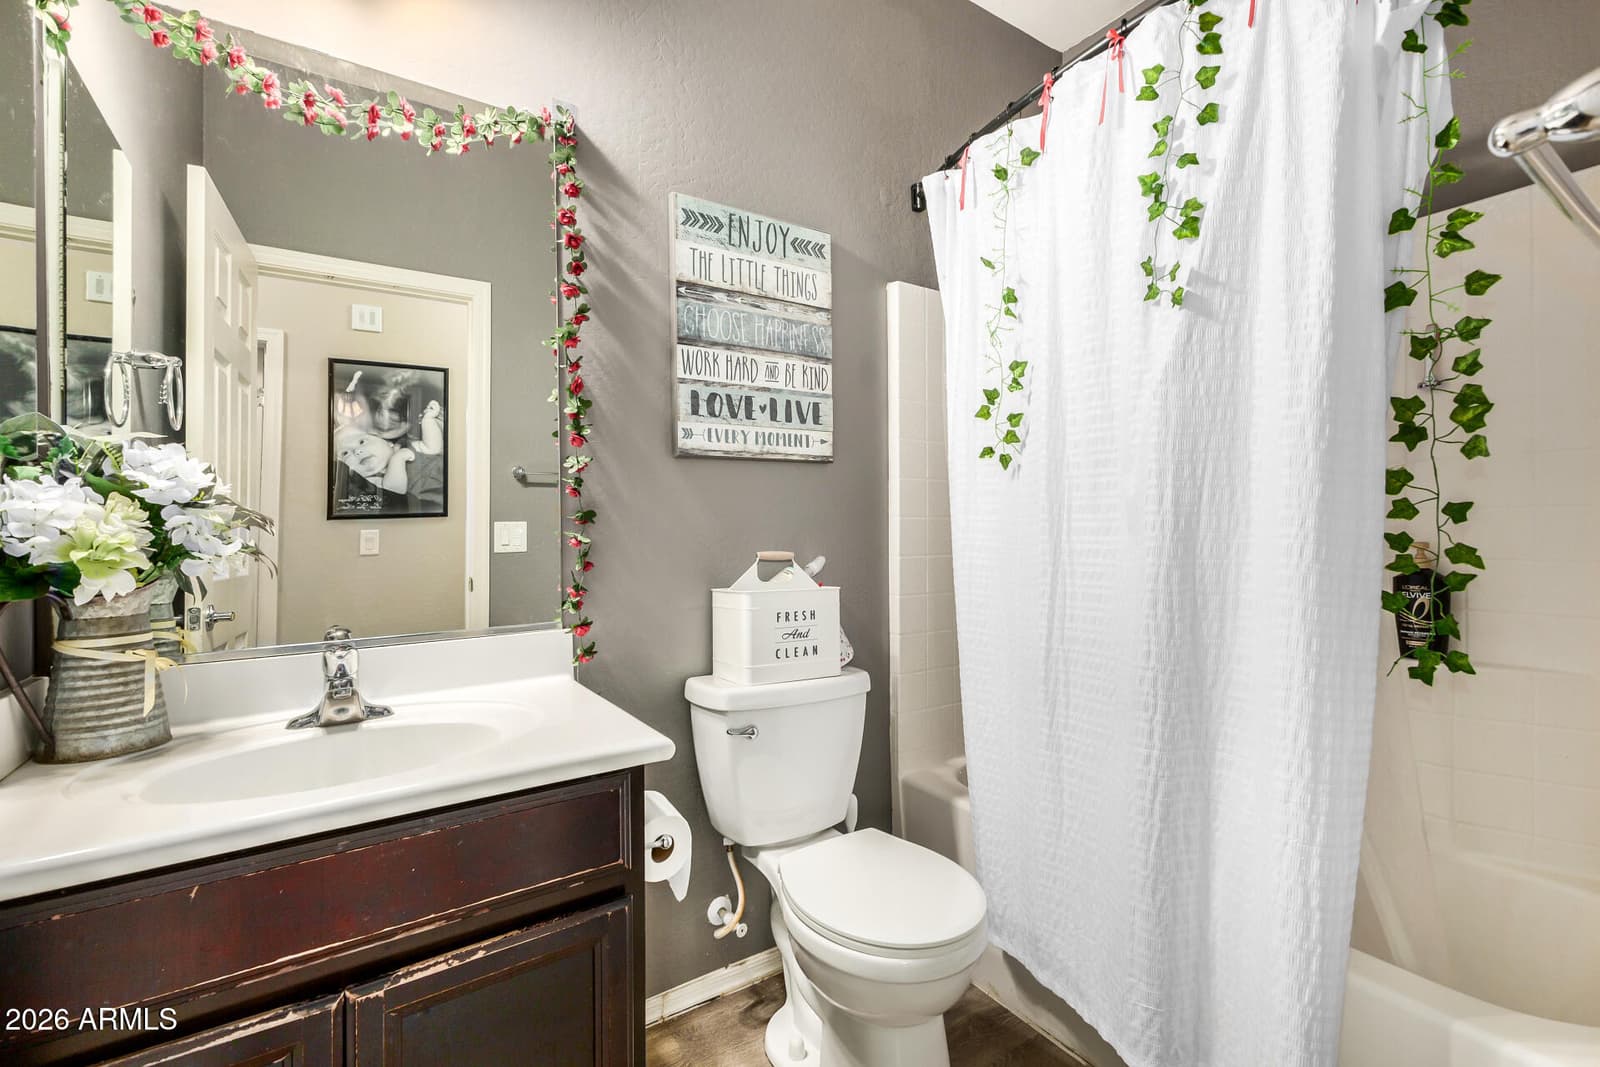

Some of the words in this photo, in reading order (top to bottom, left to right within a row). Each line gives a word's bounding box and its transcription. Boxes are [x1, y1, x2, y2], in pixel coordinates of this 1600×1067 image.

[728, 213, 790, 258] ENJOY
[690, 247, 714, 282] THE
[721, 254, 766, 293] LITTLE
[774, 265, 818, 301] THINGS
[683, 305, 749, 342] CHOOSE
[754, 318, 826, 353] HAPPINESS
[681, 349, 720, 378] WORK
[726, 354, 759, 383] HARD
[765, 364, 780, 380] AND
[785, 363, 797, 389] BE
[802, 364, 829, 391] KIND
[691, 390, 757, 420] LOVE
[769, 397, 823, 425] LIVE
[776, 610, 816, 623] FRESH
[782, 628, 811, 640] And
[775, 645, 818, 659] CLEAN
